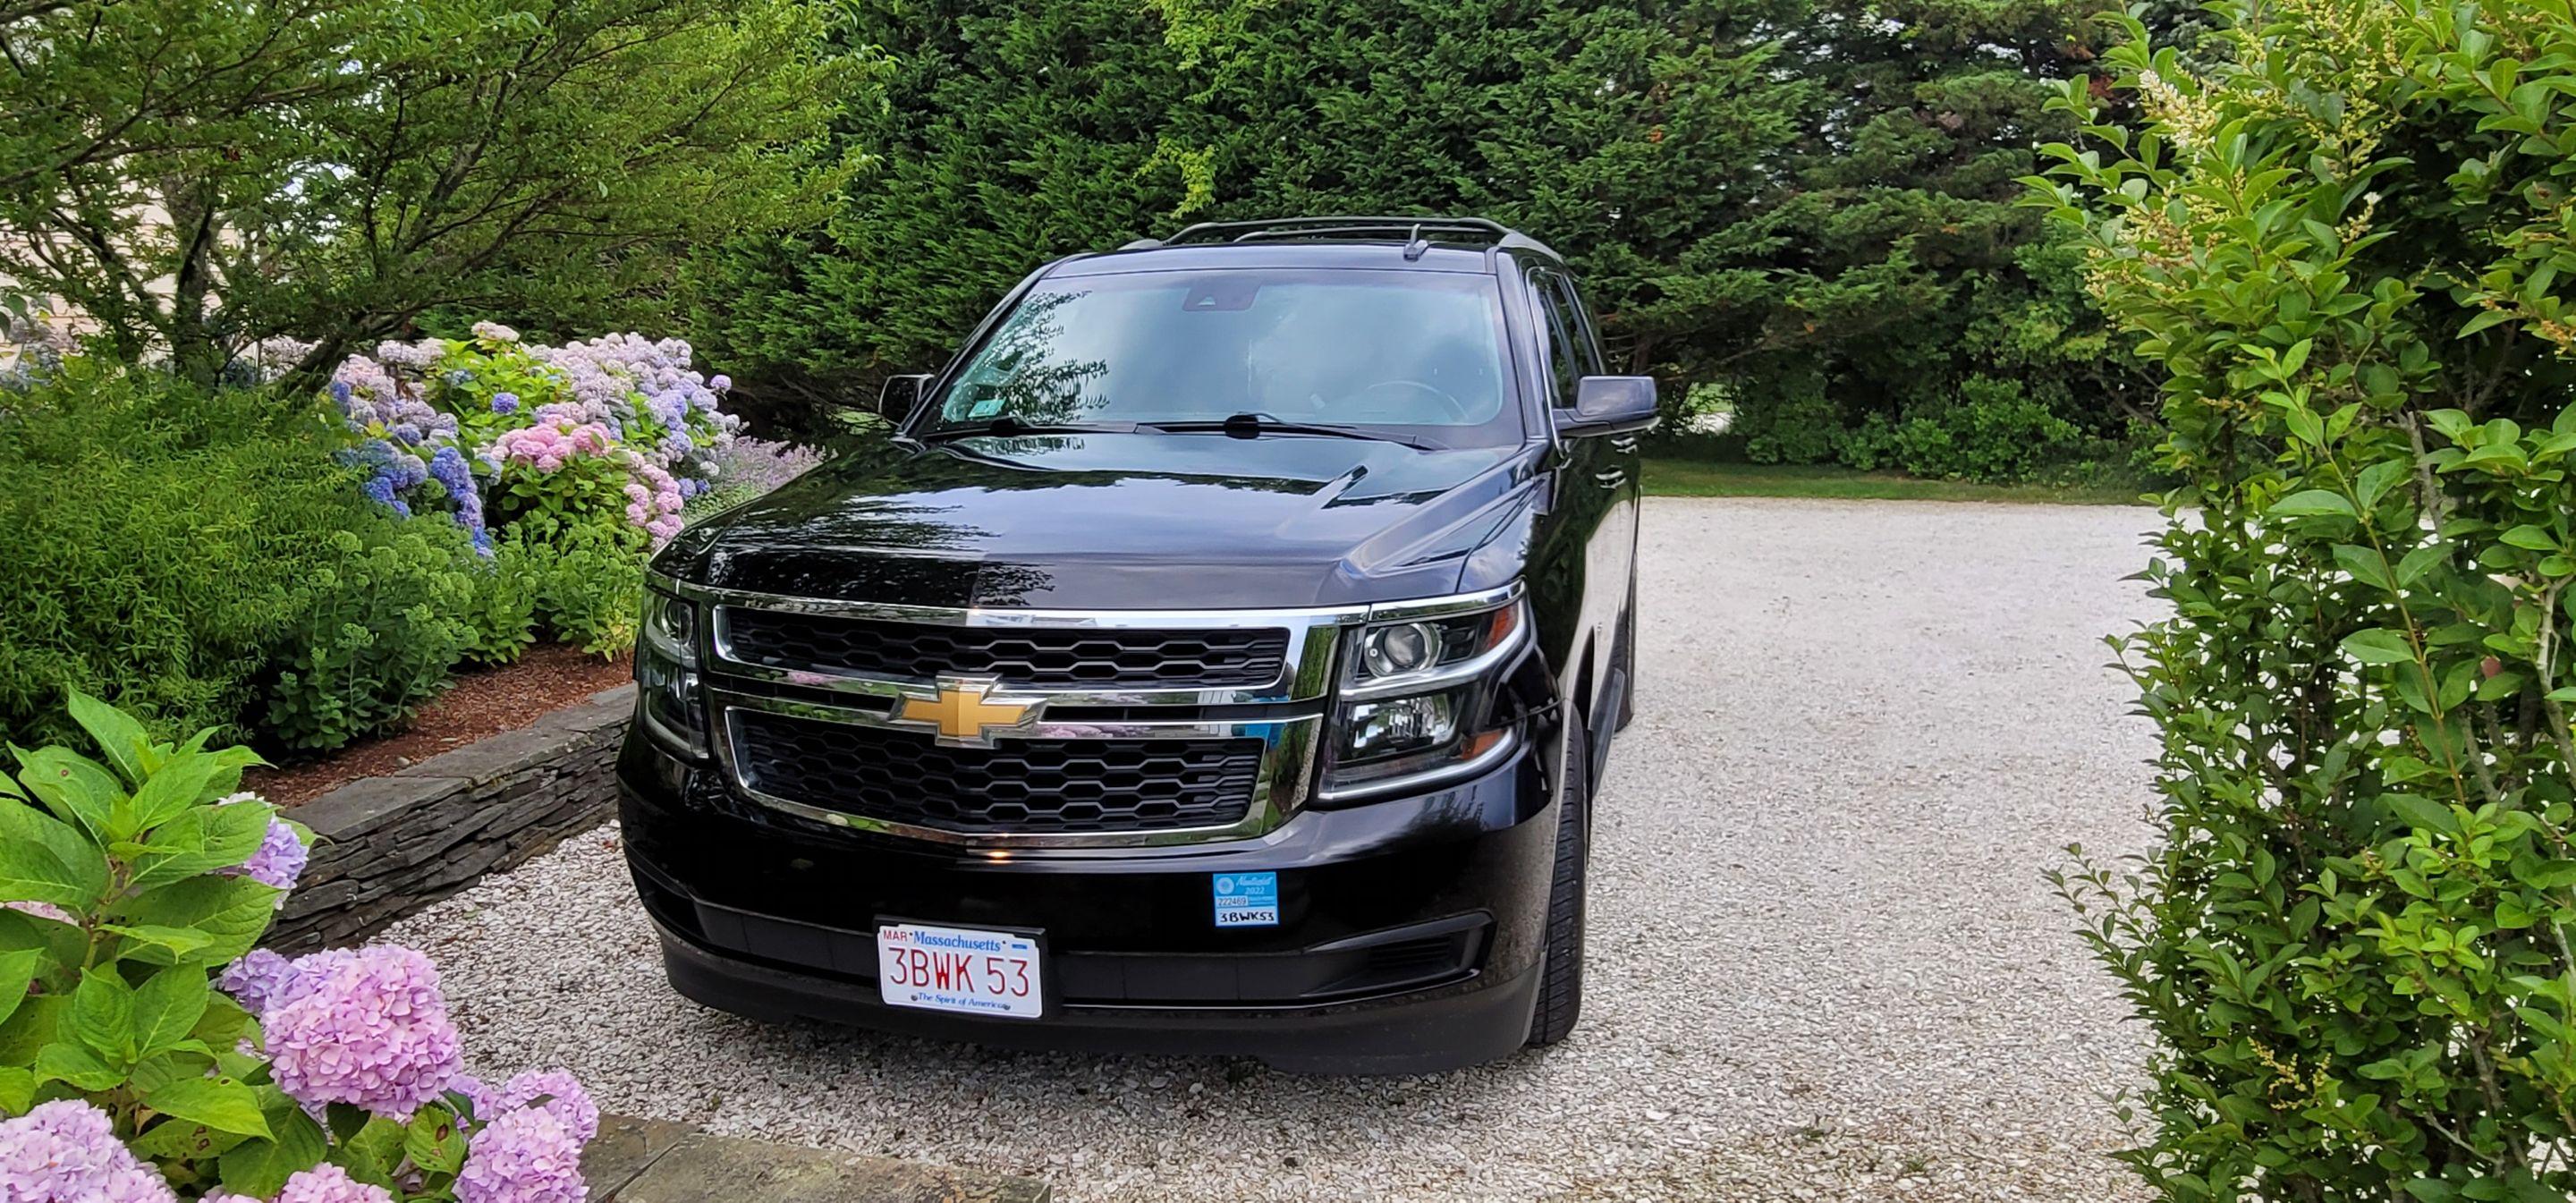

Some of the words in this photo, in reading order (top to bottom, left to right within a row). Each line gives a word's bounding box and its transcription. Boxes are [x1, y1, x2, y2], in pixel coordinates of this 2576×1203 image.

[1245, 886, 1265, 894] 2022
[1219, 911, 1275, 923] 3BWK53
[883, 929, 908, 942] MAR
[913, 930, 1001, 952] Massachusetts
[888, 946, 975, 994] 3BWK
[986, 956, 1030, 997] 53
[917, 992, 933, 1002] The
[936, 994, 956, 1004] Spirit
[958, 995, 967, 1006] of
